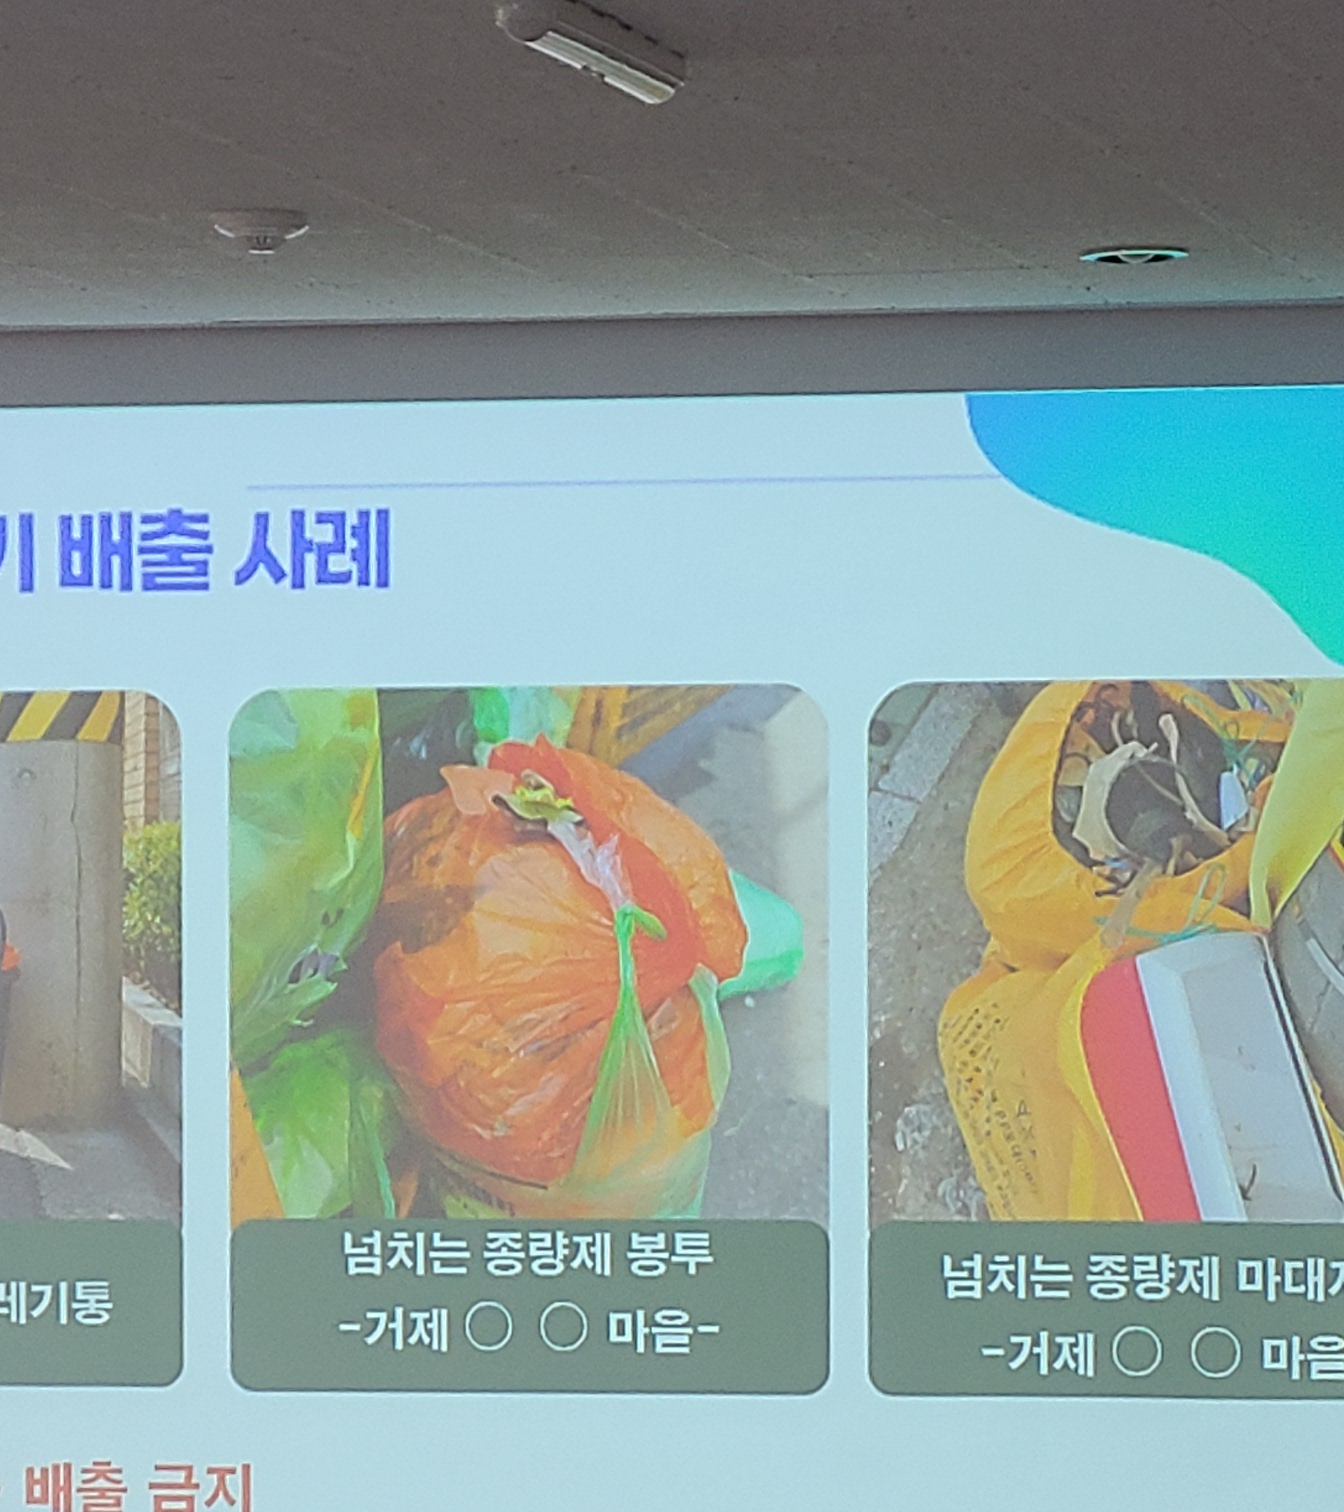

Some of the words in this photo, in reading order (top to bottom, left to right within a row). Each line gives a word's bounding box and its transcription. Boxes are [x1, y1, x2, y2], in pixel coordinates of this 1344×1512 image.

[59, 508, 214, 592] 배출
[234, 508, 390, 590] 사례
[345, 1230, 471, 1276] 넘치는
[483, 1230, 612, 1277] 종량제
[626, 1231, 714, 1277] 봉투
[943, 1253, 1074, 1300] 넘치는
[1086, 1253, 1220, 1301] 종량제
